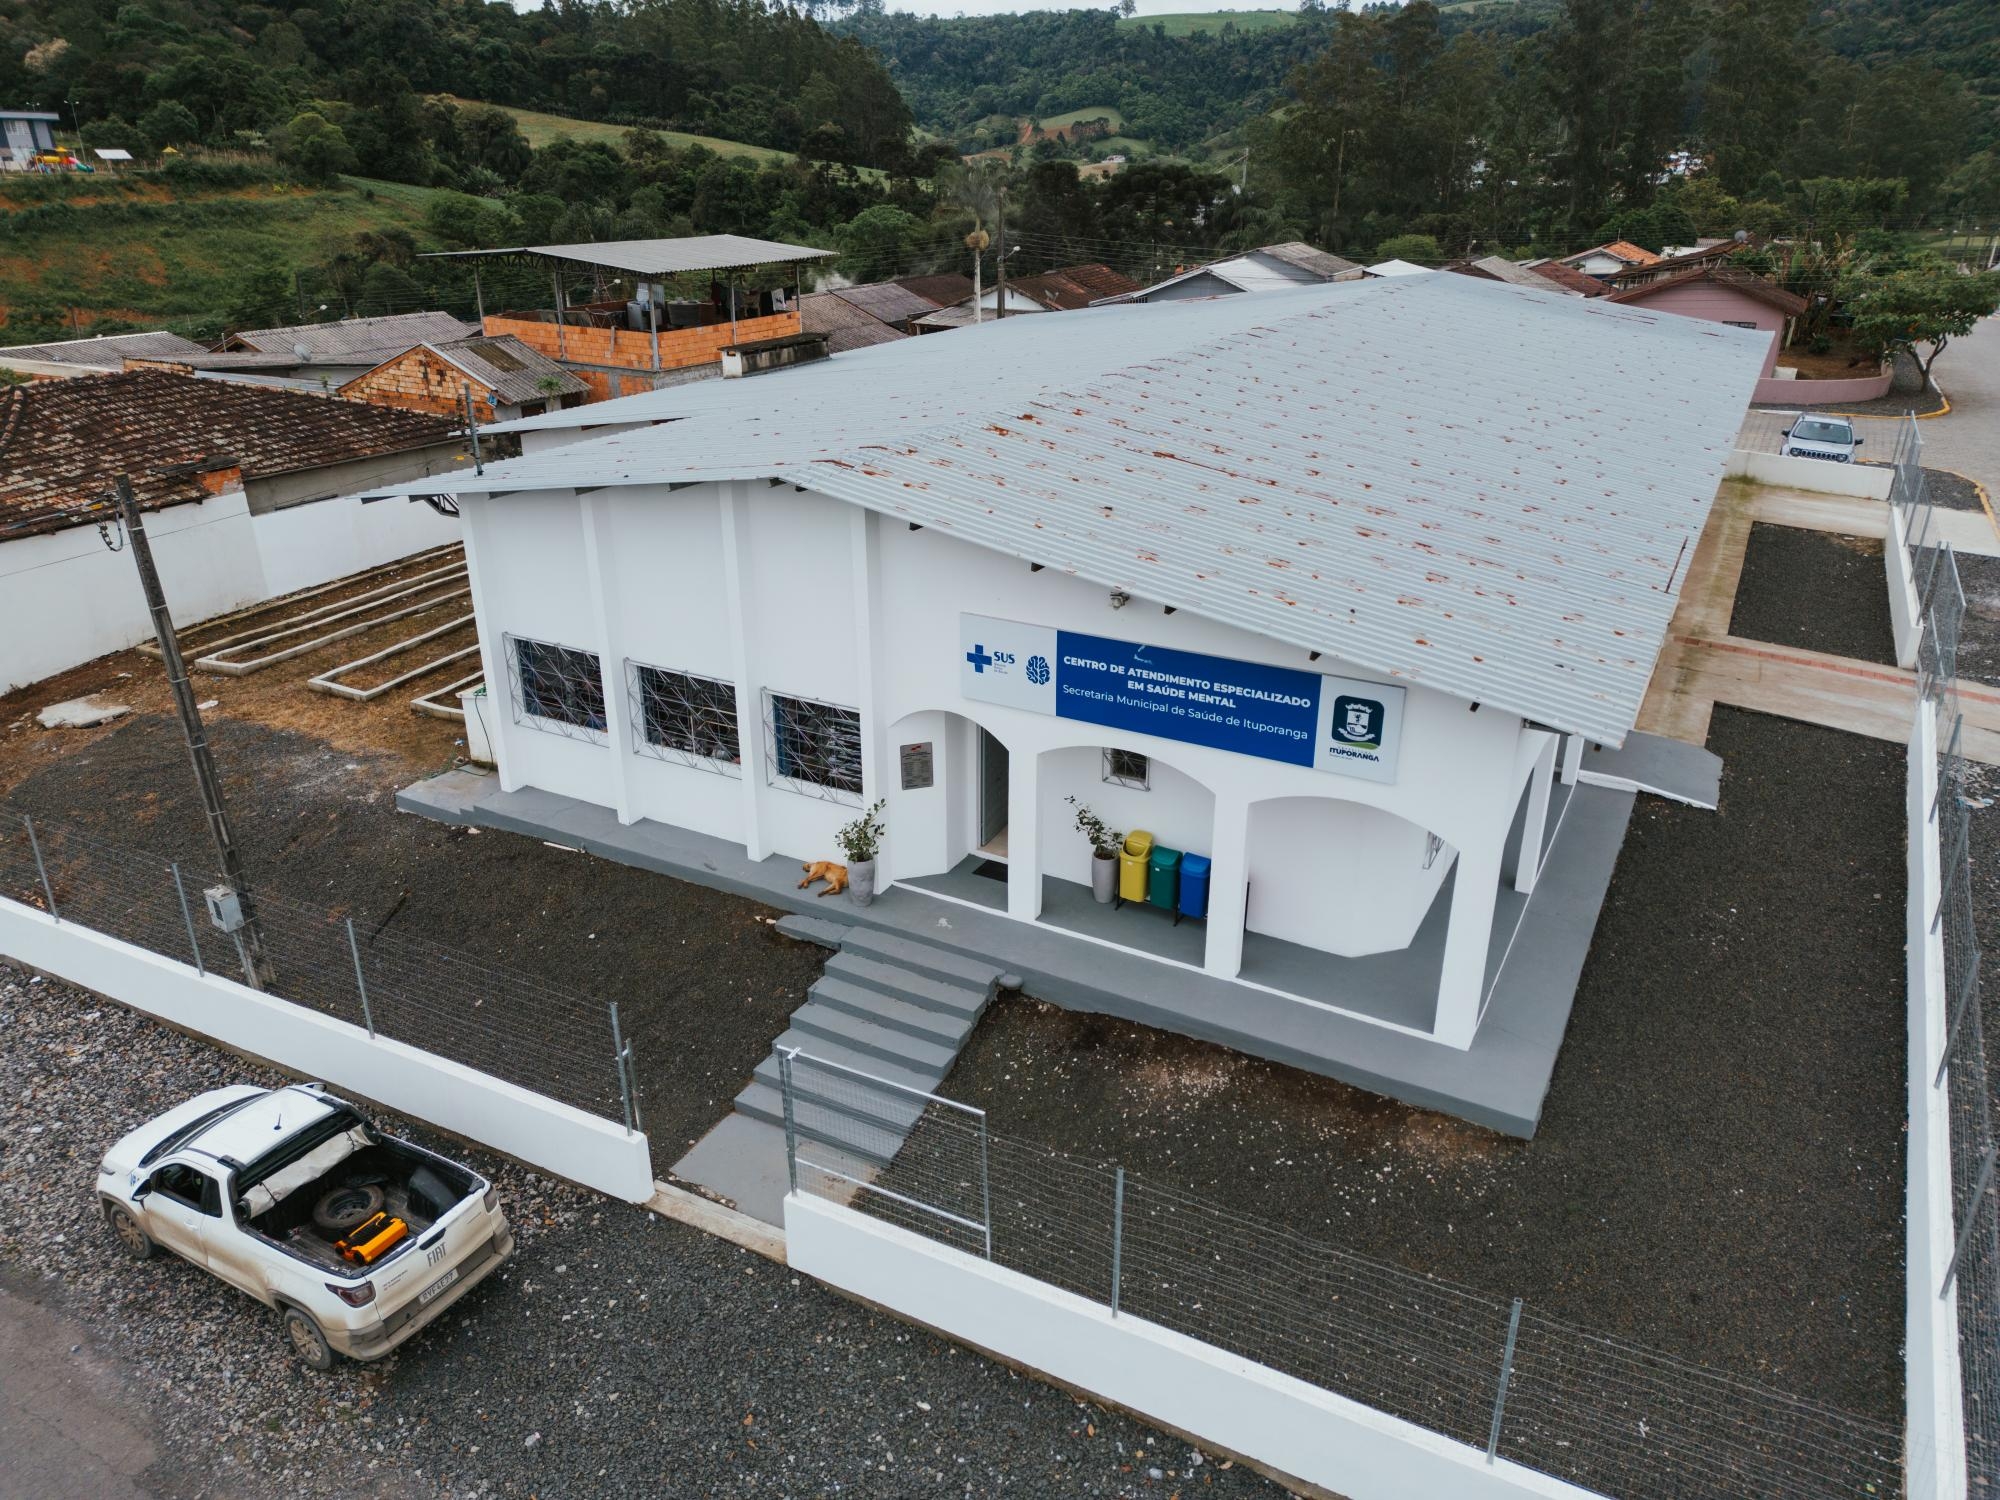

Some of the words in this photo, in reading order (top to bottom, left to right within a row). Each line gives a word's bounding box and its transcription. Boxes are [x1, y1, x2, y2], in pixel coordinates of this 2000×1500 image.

[994, 651, 1016, 664] SUS
[1063, 656, 1108, 671] CENTRO
[1110, 664, 1126, 675] DE
[1127, 668, 1210, 690] ATENDIMENTO
[1213, 682, 1312, 708] ESPECIALIZADO
[1127, 680, 1145, 691] EM
[1147, 684, 1186, 699] SAÚDE
[1188, 691, 1237, 709] MENTAL
[1063, 684, 1114, 702] Secretaria
[1116, 694, 1169, 713] Municipal
[1171, 705, 1186, 716] de
[1188, 708, 1223, 723] Saúde
[1226, 716, 1241, 726] de
[1243, 719, 1308, 740] Ituporanga
[1330, 747, 1380, 763] ITUPORANGA
[427, 1242, 447, 1268] FIAT
